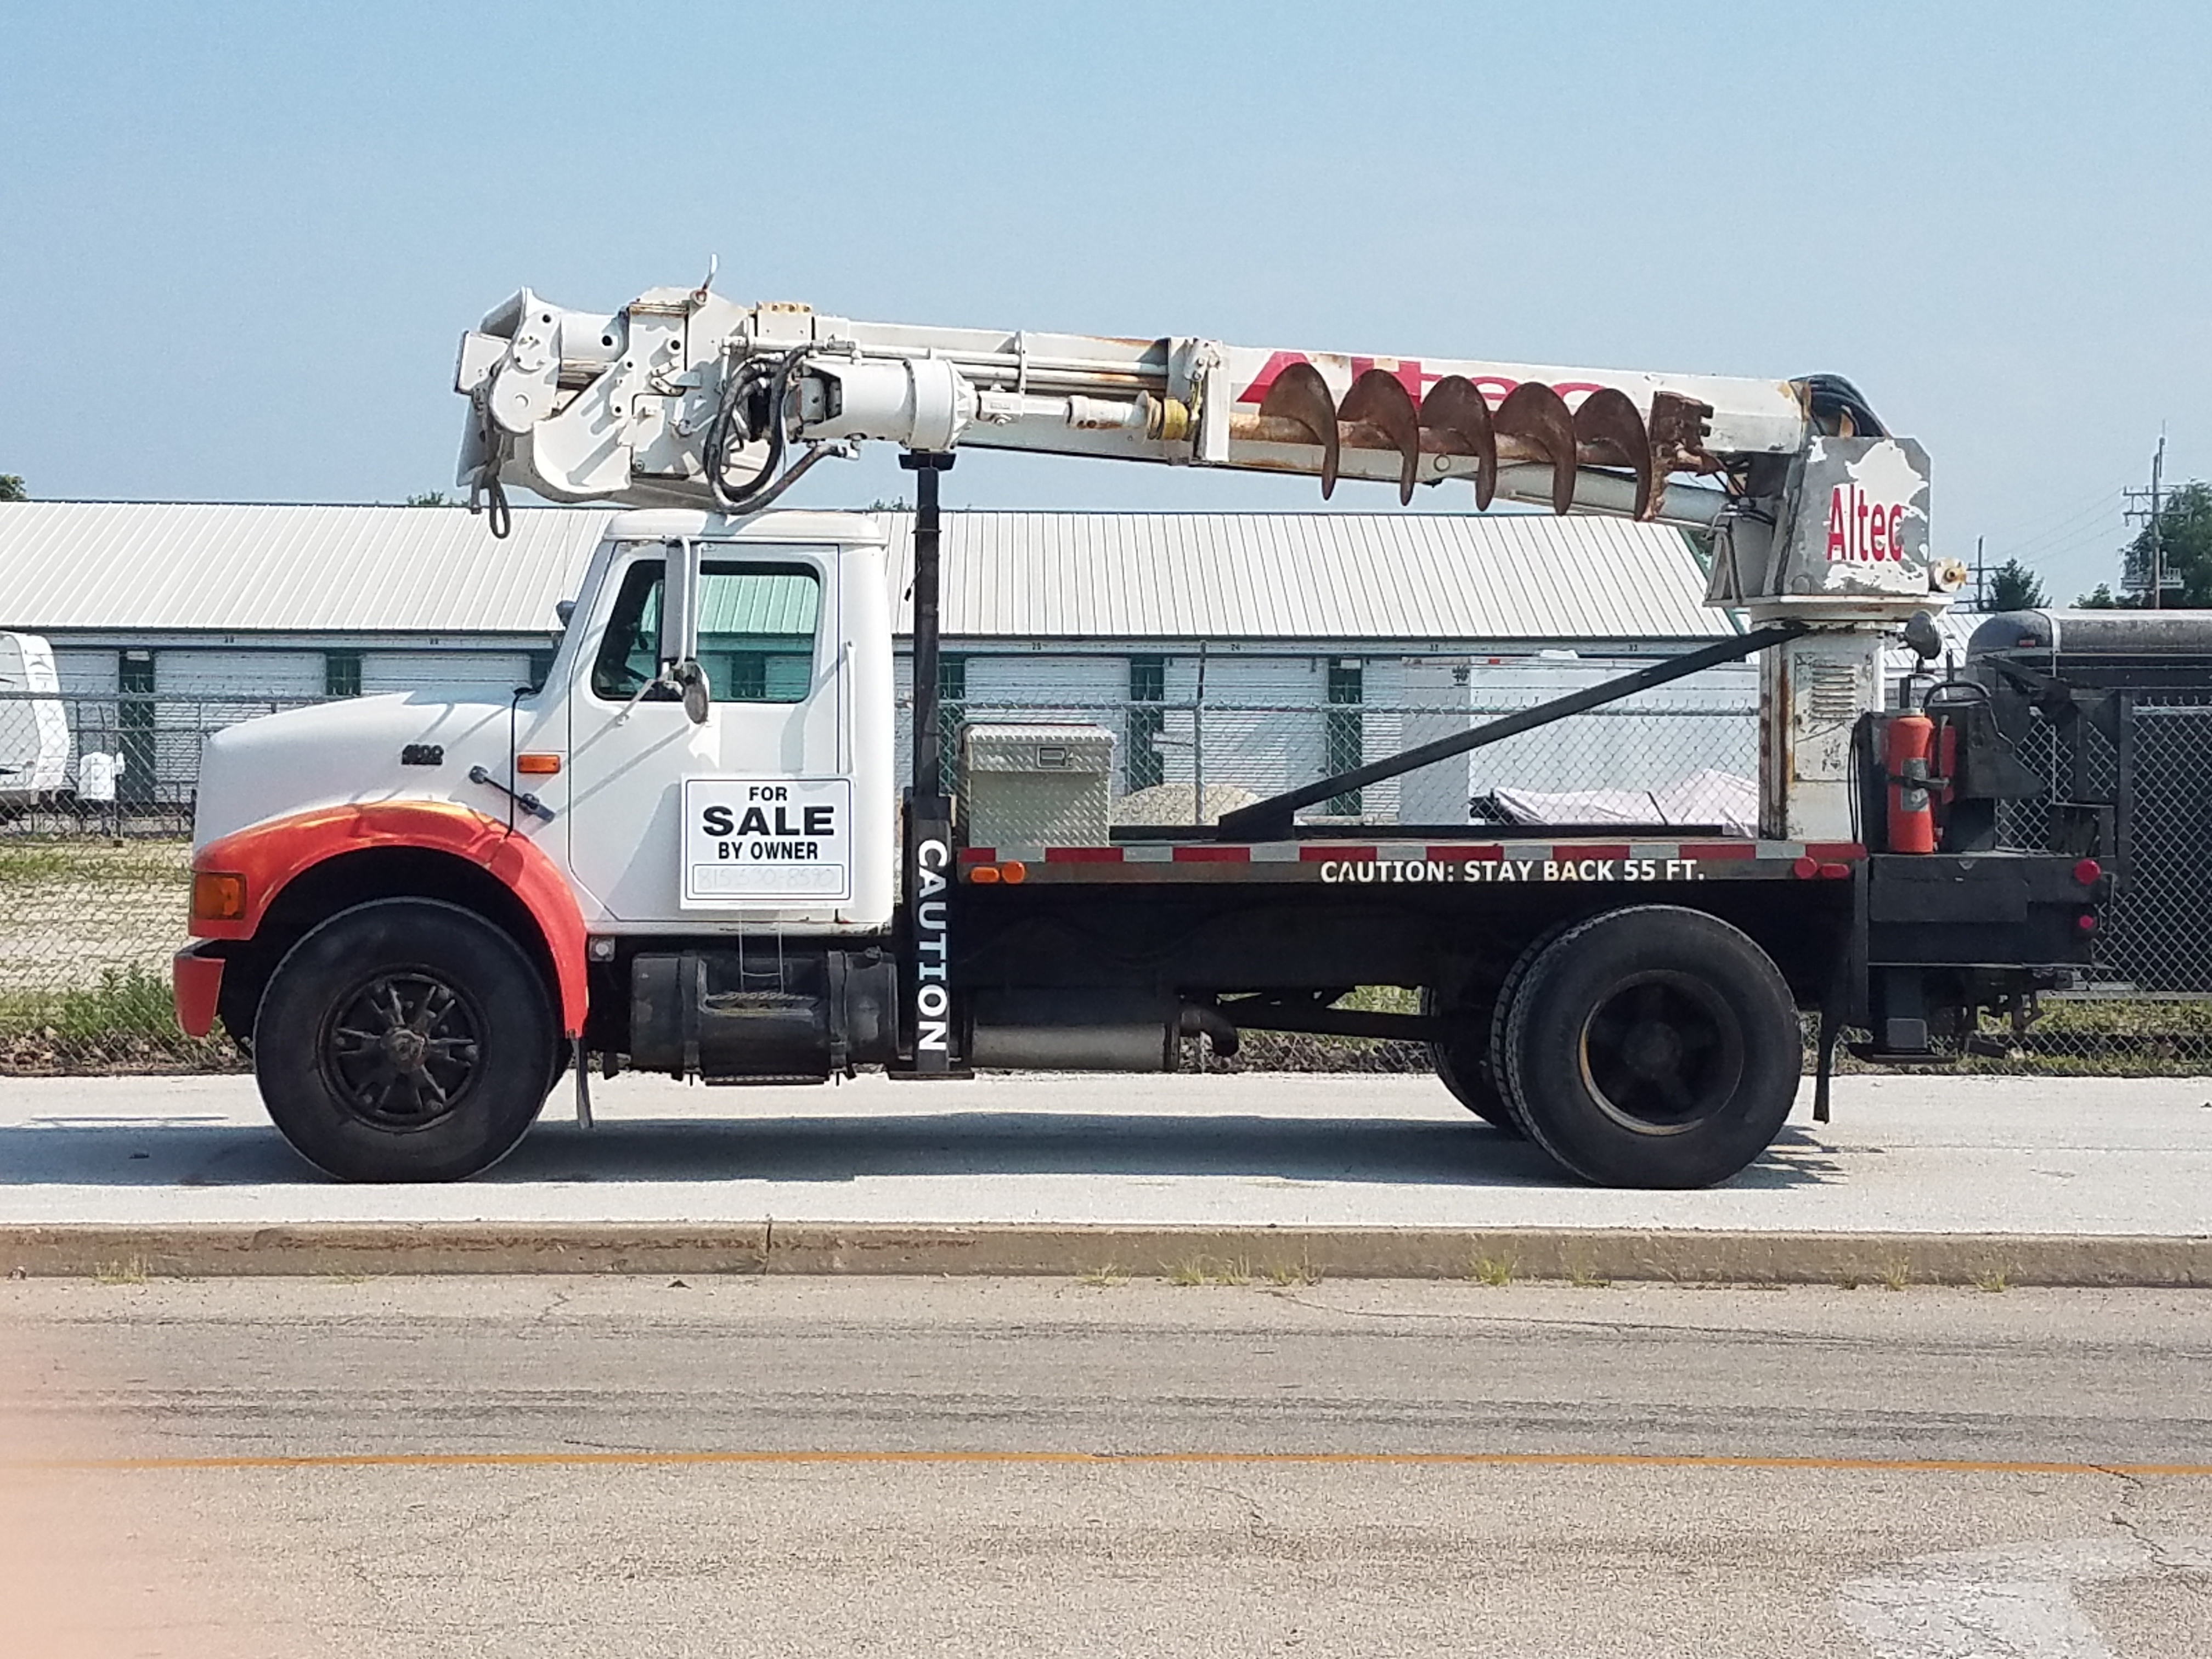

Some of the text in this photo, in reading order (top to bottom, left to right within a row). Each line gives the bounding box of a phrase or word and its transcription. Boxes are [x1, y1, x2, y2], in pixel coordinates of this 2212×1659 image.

[1826, 483, 1903, 562] Altec
[748, 786, 787, 801] FOR
[702, 805, 834, 837] SALE
[718, 842, 818, 860] BY OWNER
[1321, 859, 1705, 883] CAUTION: STAY BACK 55 FT.
[918, 839, 947, 1051] CAUTION
